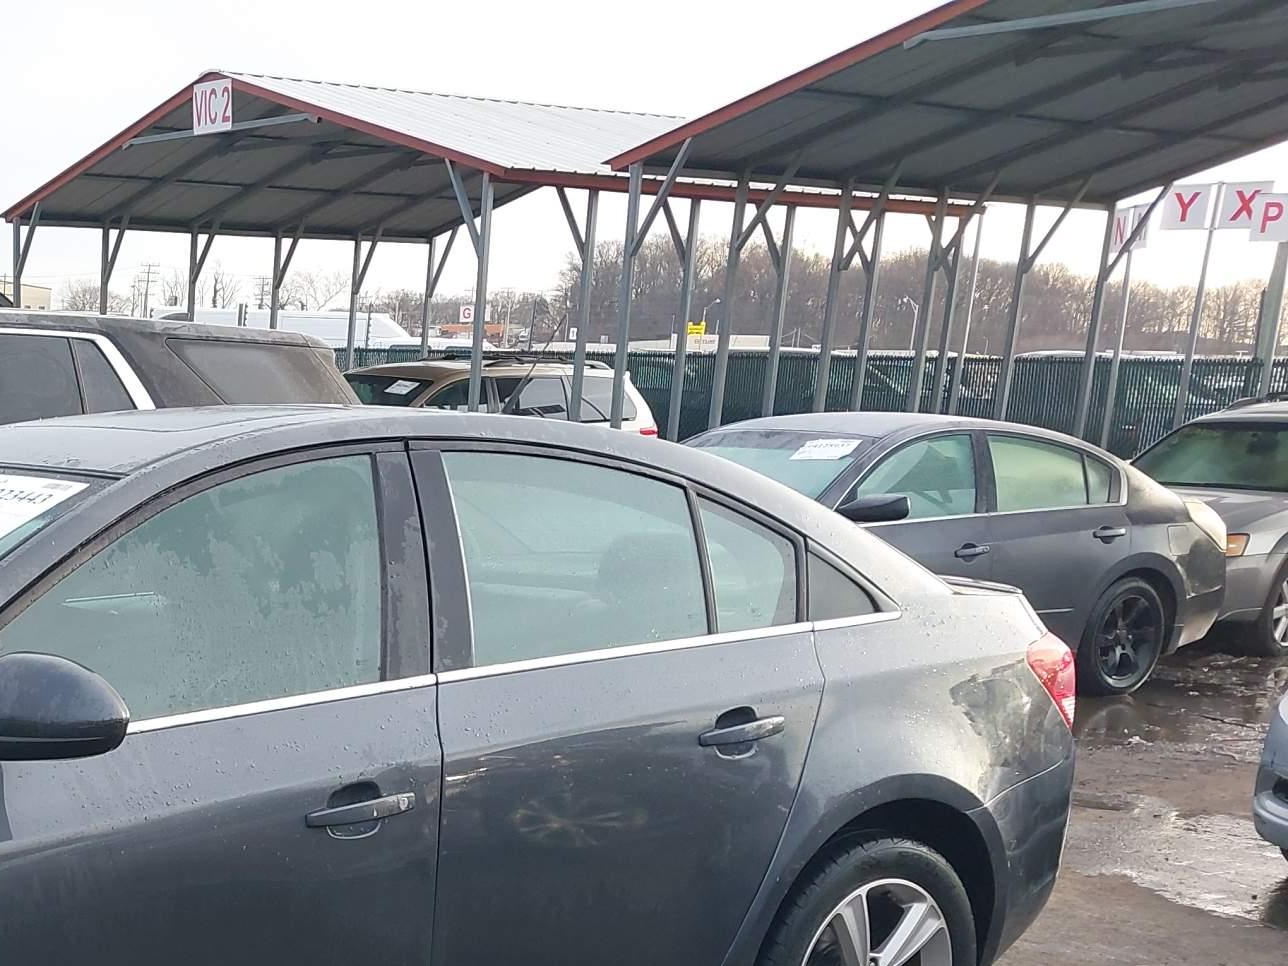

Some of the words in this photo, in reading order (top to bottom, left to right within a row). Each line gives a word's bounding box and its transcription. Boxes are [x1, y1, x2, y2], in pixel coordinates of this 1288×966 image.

[195, 88, 217, 127] VIC
[222, 87, 230, 123] 2
[1175, 191, 1202, 222] Y
[1229, 189, 1262, 221] X
[1260, 202, 1284, 233] P
[1114, 215, 1127, 245] N
[463, 307, 472, 319] G
